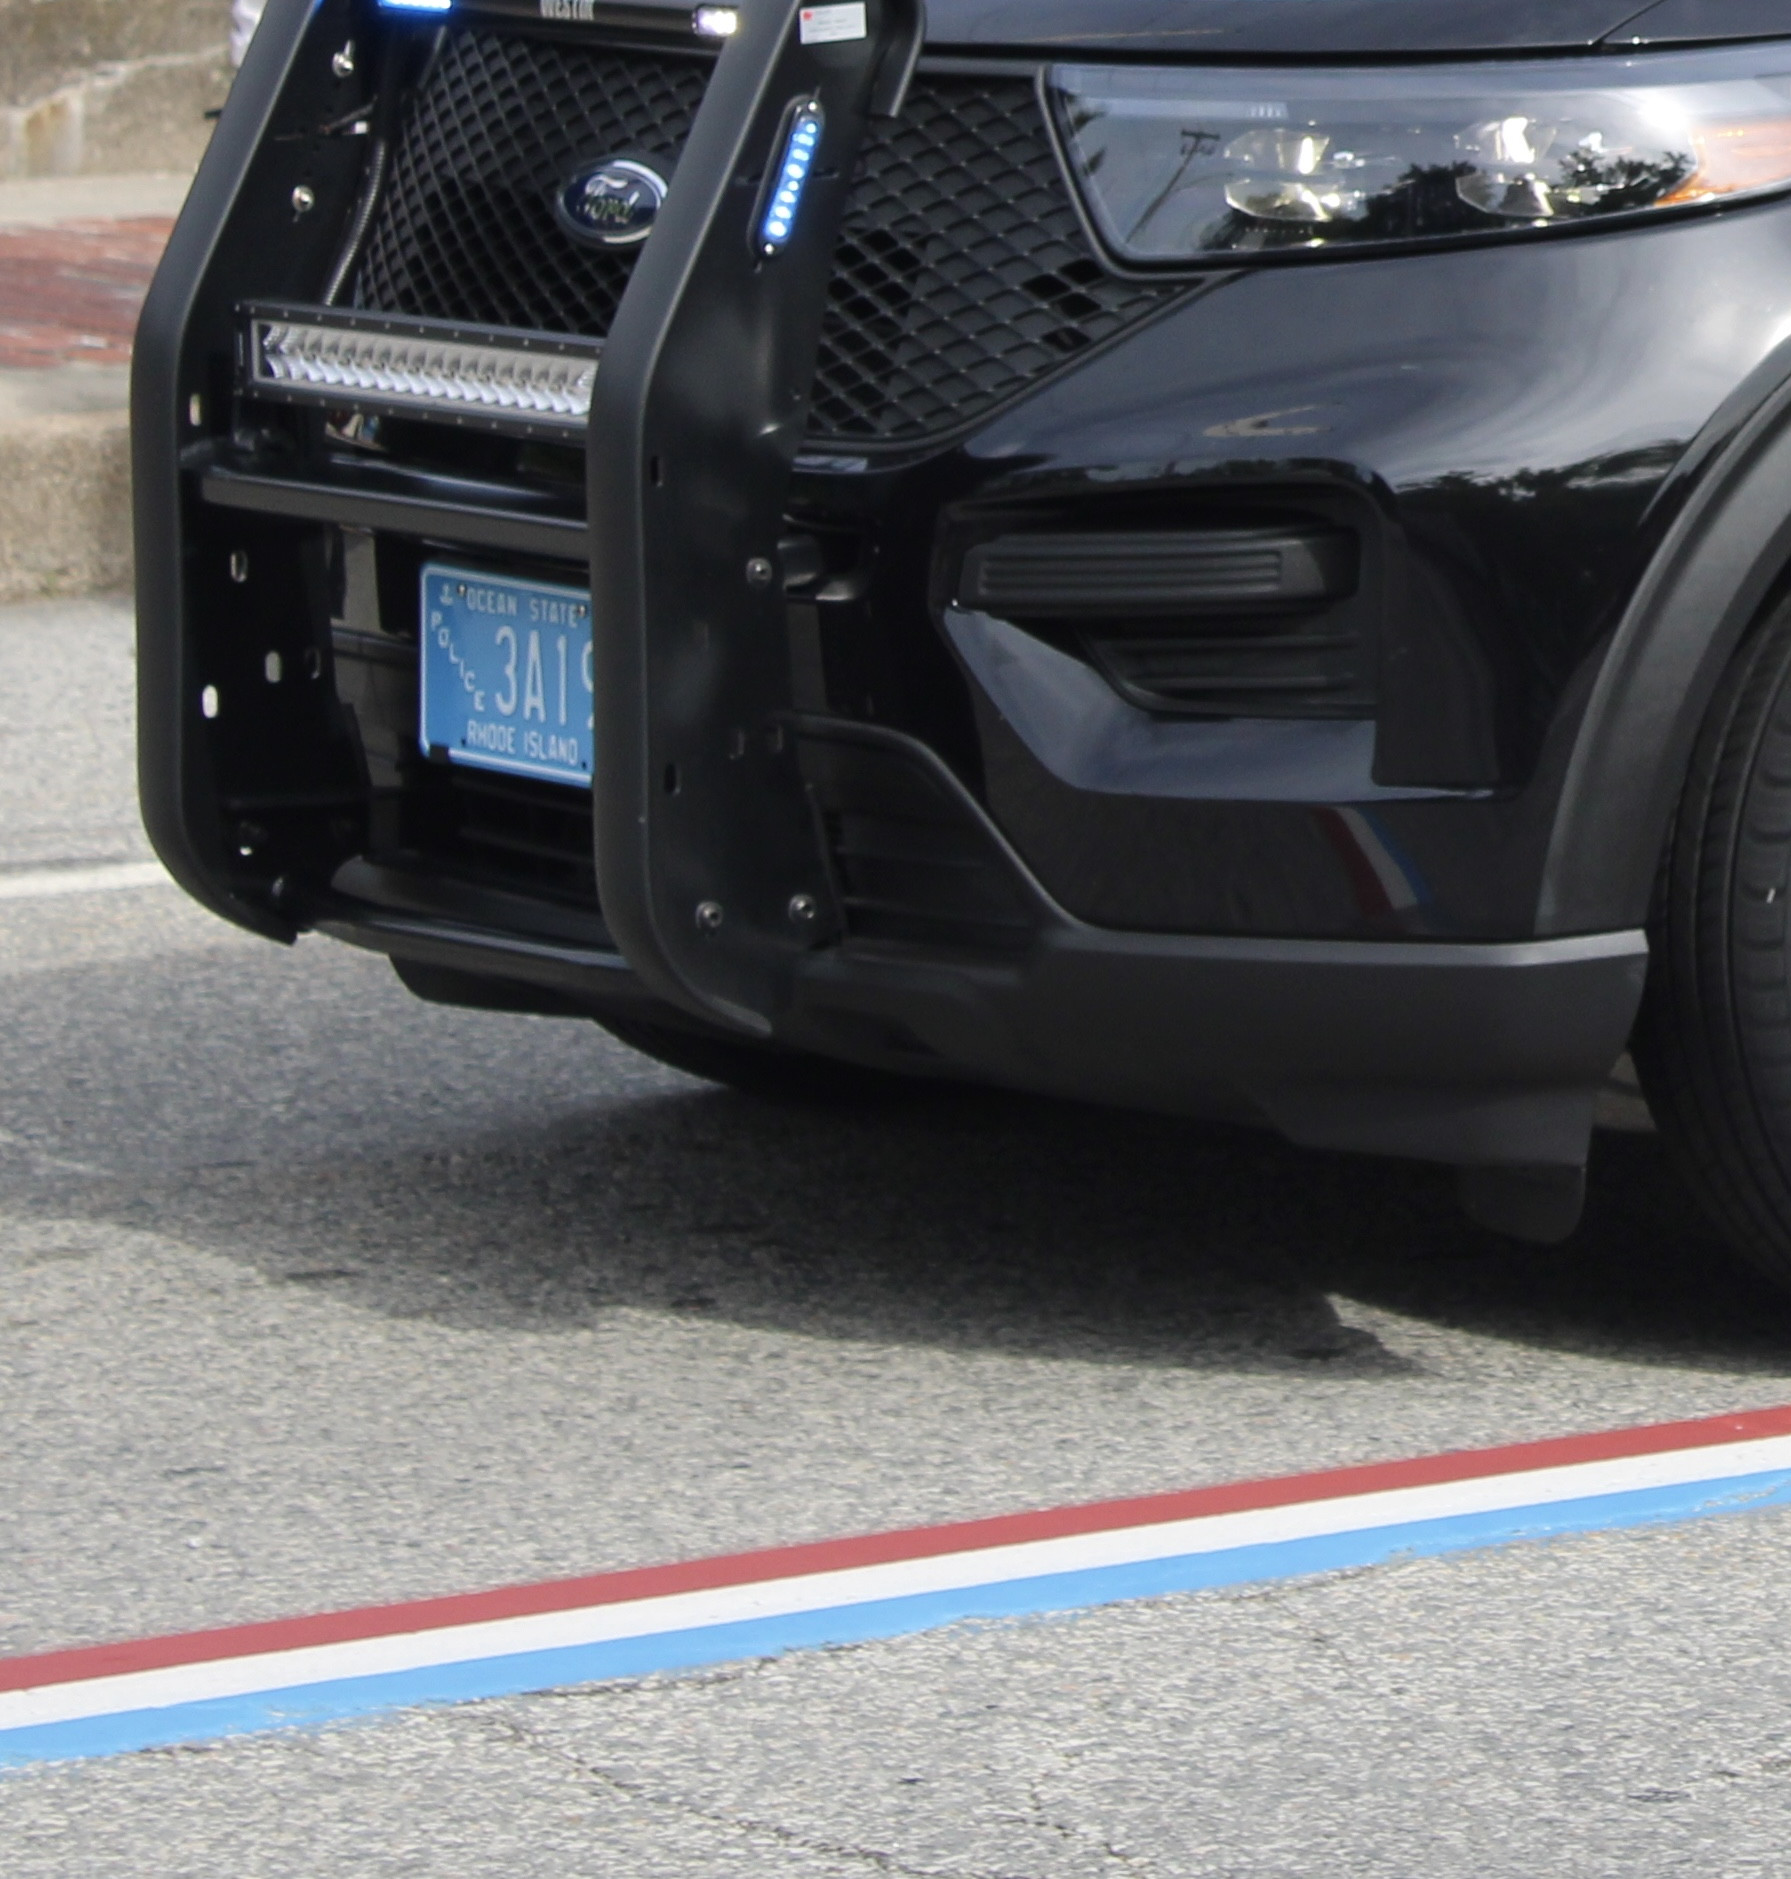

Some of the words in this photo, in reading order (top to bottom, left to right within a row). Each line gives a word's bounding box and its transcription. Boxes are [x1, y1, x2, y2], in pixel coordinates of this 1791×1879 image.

[467, 588, 517, 616] OCEAN
[529, 599, 579, 628] STATE
[431, 610, 485, 712] POLICE
[467, 720, 516, 755] RHODE
[524, 730, 579, 766] ISLAND
